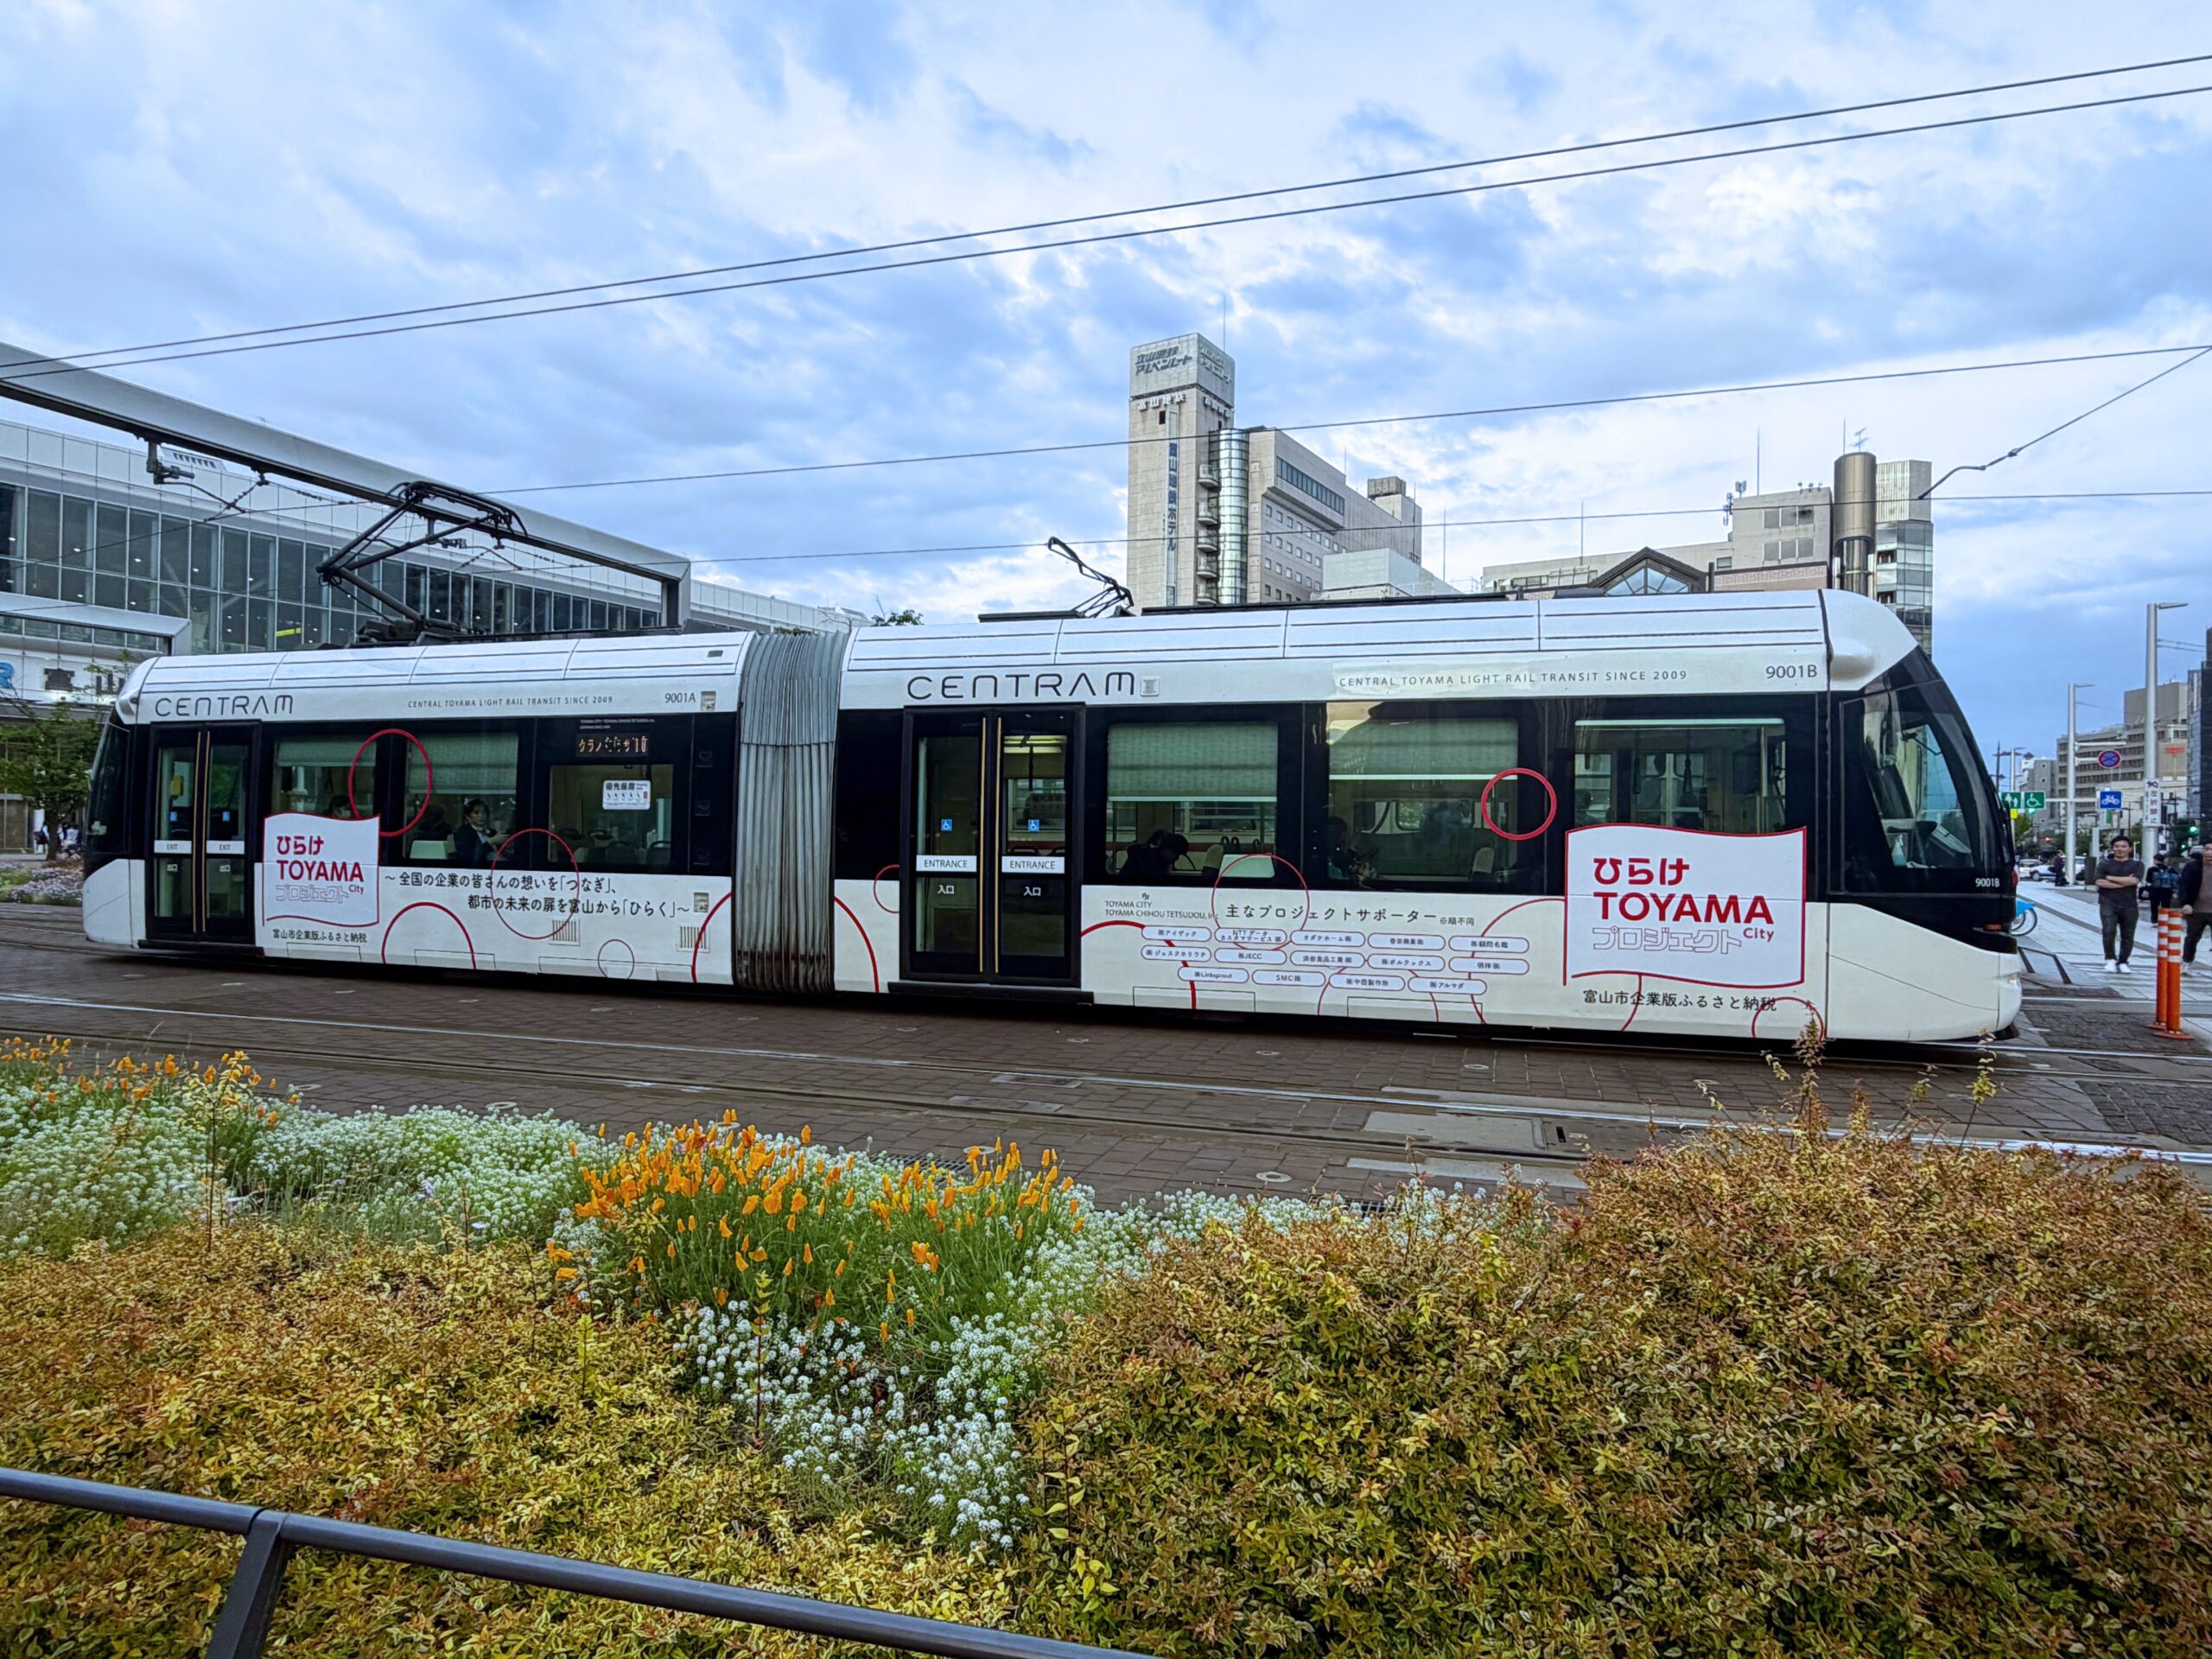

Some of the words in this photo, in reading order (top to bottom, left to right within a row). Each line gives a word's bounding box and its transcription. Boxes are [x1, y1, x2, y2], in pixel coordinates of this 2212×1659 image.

[1339, 677, 1395, 686] CENTRAL
[1402, 676, 1453, 685] TOYAMA
[1460, 674, 1499, 684] LIGHT
[1506, 673, 1535, 683] RAIL
[1541, 671, 1599, 683] TRANSIT
[1605, 671, 1646, 681] SINCE
[1653, 670, 1687, 680] 2009
[1765, 664, 1818, 679] 9001B
[907, 671, 1135, 700] CENTRAM
[155, 694, 294, 717] CENTRAM
[527, 696, 562, 705] TRANSIT
[664, 692, 696, 704] 9001A
[276, 836, 325, 855] ひらけ
[276, 860, 364, 882] TOYAMA
[924, 859, 969, 868] ENTRANCE
[1009, 860, 1055, 869] ENTRANCE
[1593, 858, 1689, 886] ひらけ
[348, 884, 364, 894] City
[938, 884, 955, 894] 入口
[1975, 877, 2000, 888] 9001B
[275, 883, 350, 904] プロジェクト
[1023, 887, 1041, 896] 入口
[1225, 903, 1437, 924] 主なプロジェクトサポーター
[1593, 892, 1774, 925] TOYAMA
[272, 928, 367, 943] 富山市企業版ふるさと納税
[1592, 926, 1742, 954] プロジェクト
[1742, 926, 1774, 942] City
[1582, 989, 1777, 1012] 富山市企業版ふるさと納税
